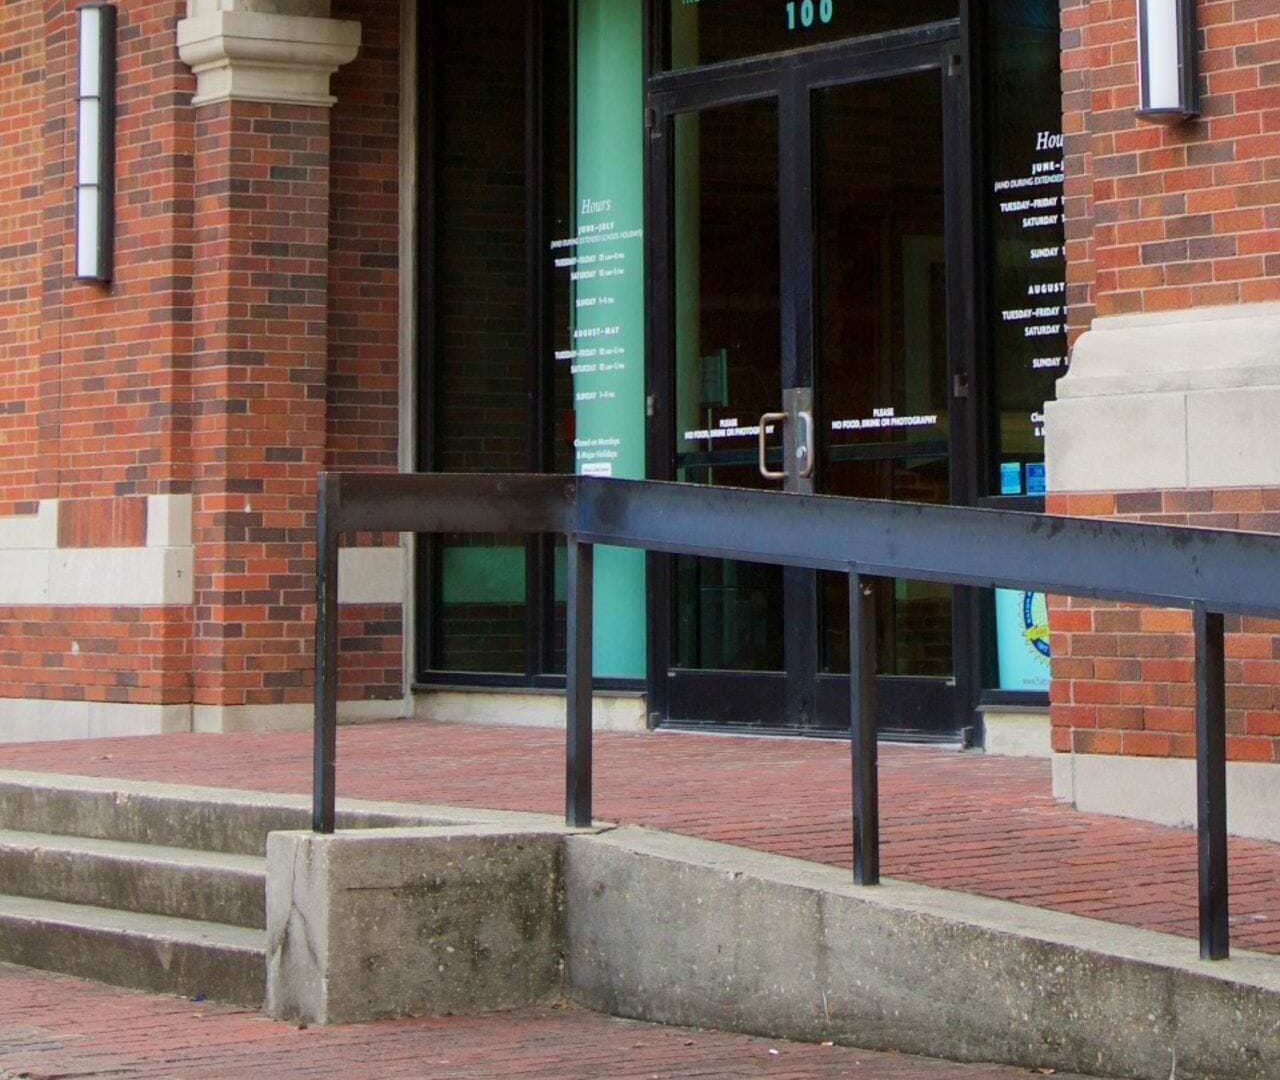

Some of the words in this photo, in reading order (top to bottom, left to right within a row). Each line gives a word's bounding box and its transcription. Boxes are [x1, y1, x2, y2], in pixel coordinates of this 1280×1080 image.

[1010, 178, 1034, 189] DURING
[580, 200, 612, 214] Hours
[1022, 215, 1058, 227] SATURDAY
[1030, 247, 1059, 259] SUNDAY
[1024, 325, 1060, 336] SATURDAY
[1032, 358, 1061, 368] SUNDAY
[873, 408, 894, 417] PLEASE
[831, 421, 842, 430] NO
[861, 419, 880, 428] DRINK
[881, 418, 890, 427] OR
[891, 416, 938, 426] PHOTOGRAPHY
